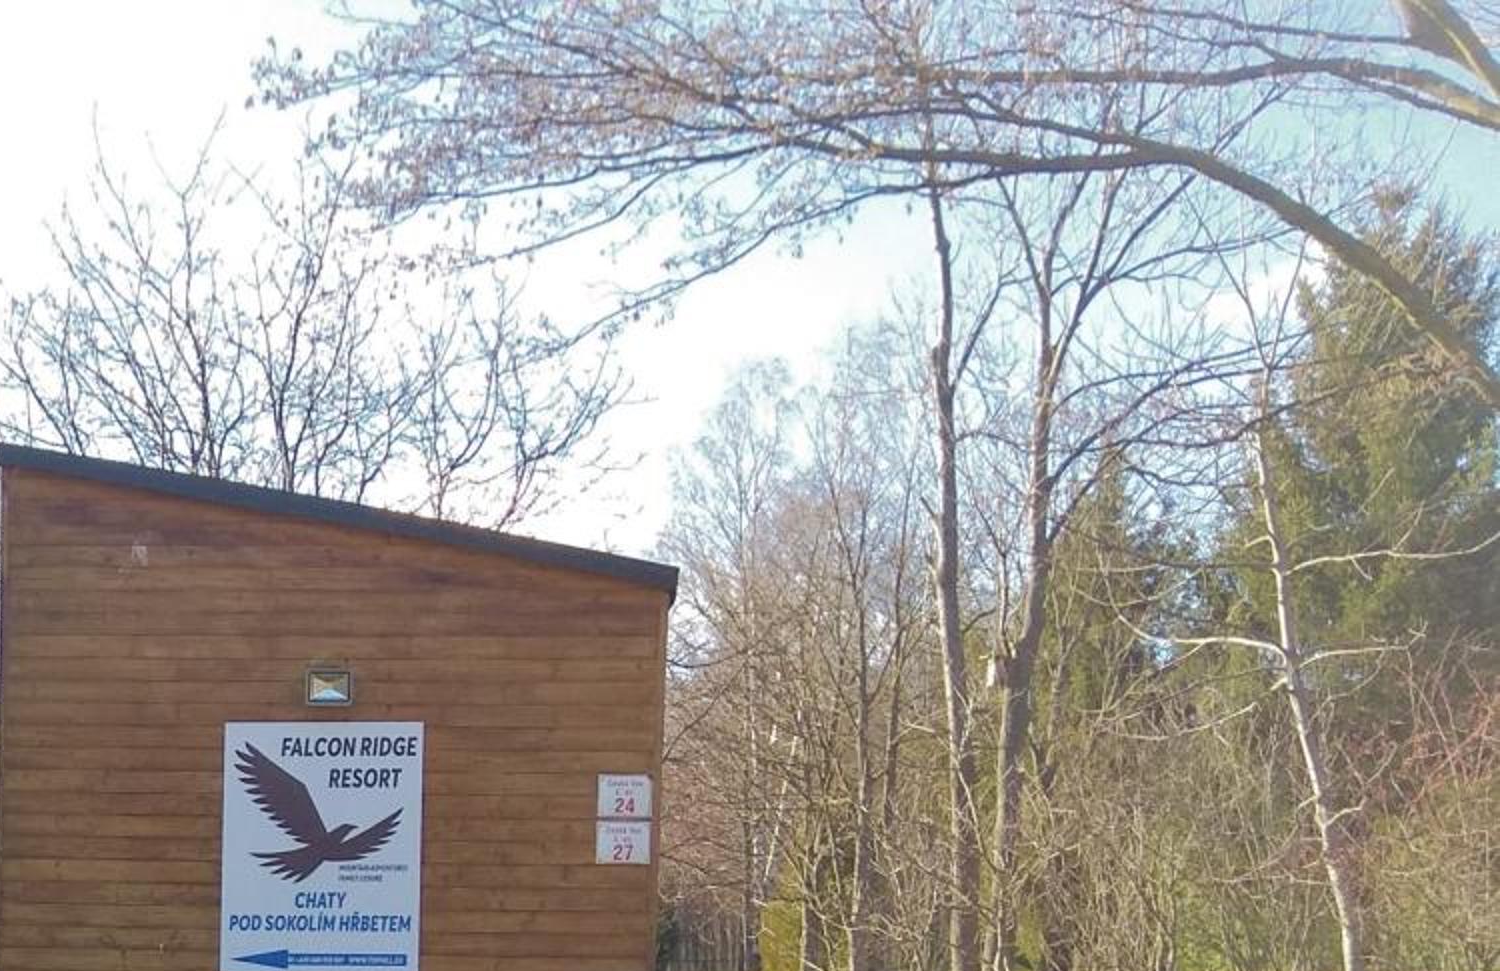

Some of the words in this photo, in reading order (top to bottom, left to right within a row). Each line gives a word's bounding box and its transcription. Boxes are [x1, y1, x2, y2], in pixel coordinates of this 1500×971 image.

[281, 737, 357, 757] FALCON
[360, 736, 418, 757] RIDGE
[328, 768, 402, 788] RESORT
[615, 797, 635, 813] 24
[613, 844, 633, 861] 27
[294, 892, 346, 909] CHATY
[229, 915, 262, 931] POD
[265, 912, 336, 931] SOKOLÍM
[339, 912, 411, 932] HŘBETEM
